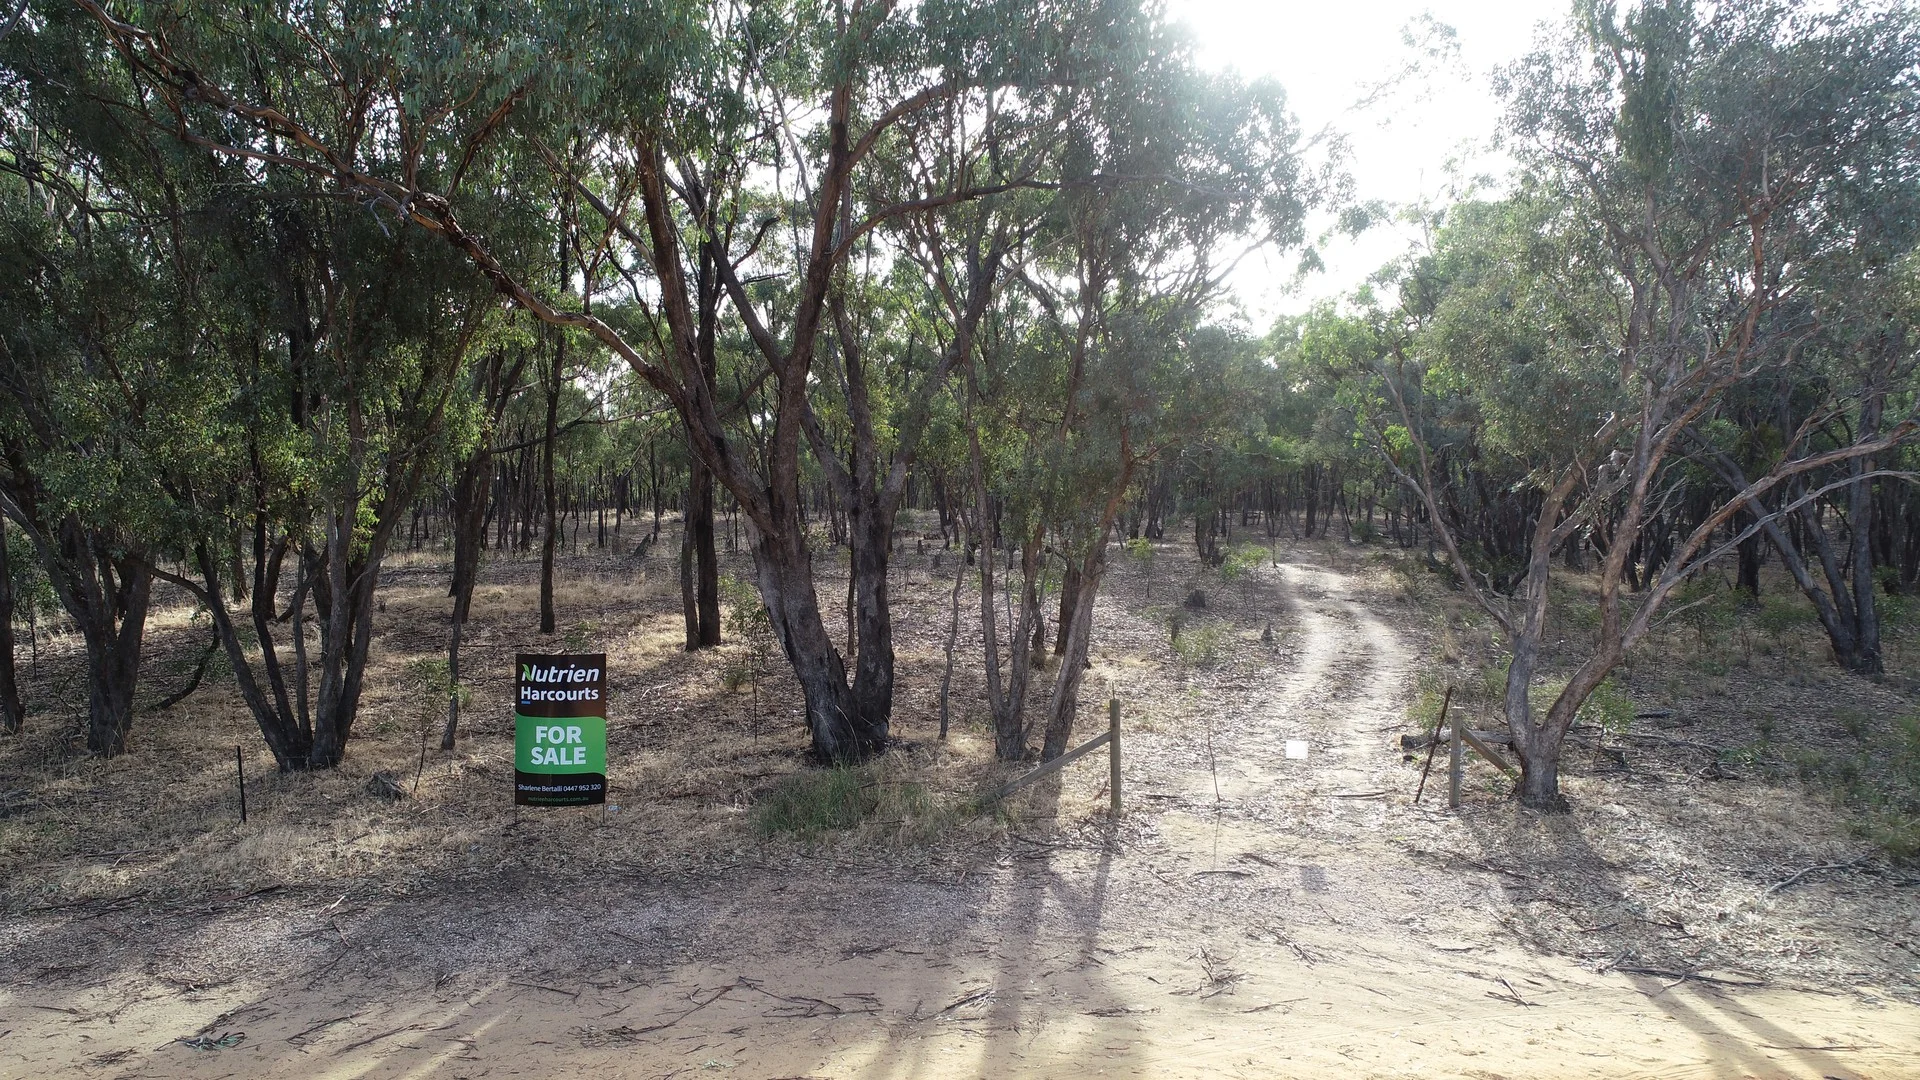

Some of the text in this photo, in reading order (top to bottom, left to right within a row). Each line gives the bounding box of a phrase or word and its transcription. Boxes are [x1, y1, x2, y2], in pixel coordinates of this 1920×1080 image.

[521, 663, 600, 683] Nutrien
[521, 686, 599, 701] Harcourts
[535, 725, 582, 744] FOR
[530, 746, 587, 765] SALE
